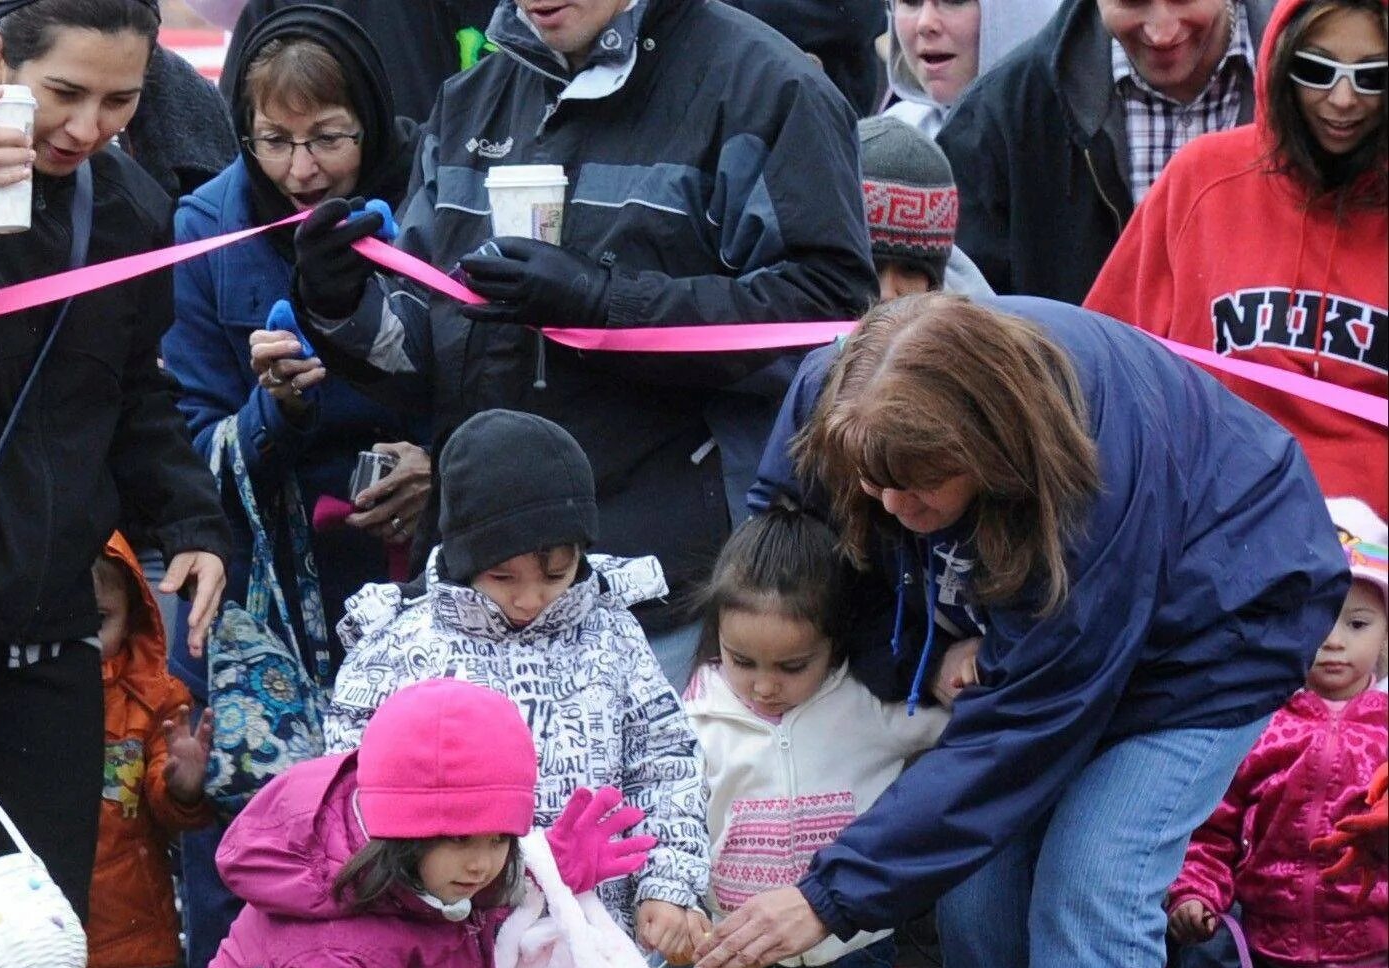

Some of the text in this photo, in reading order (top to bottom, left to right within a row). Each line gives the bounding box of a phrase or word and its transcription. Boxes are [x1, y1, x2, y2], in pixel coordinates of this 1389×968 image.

[559, 702, 587, 748] 1972
[588, 709, 605, 734] THE
[590, 737, 607, 762] ART
